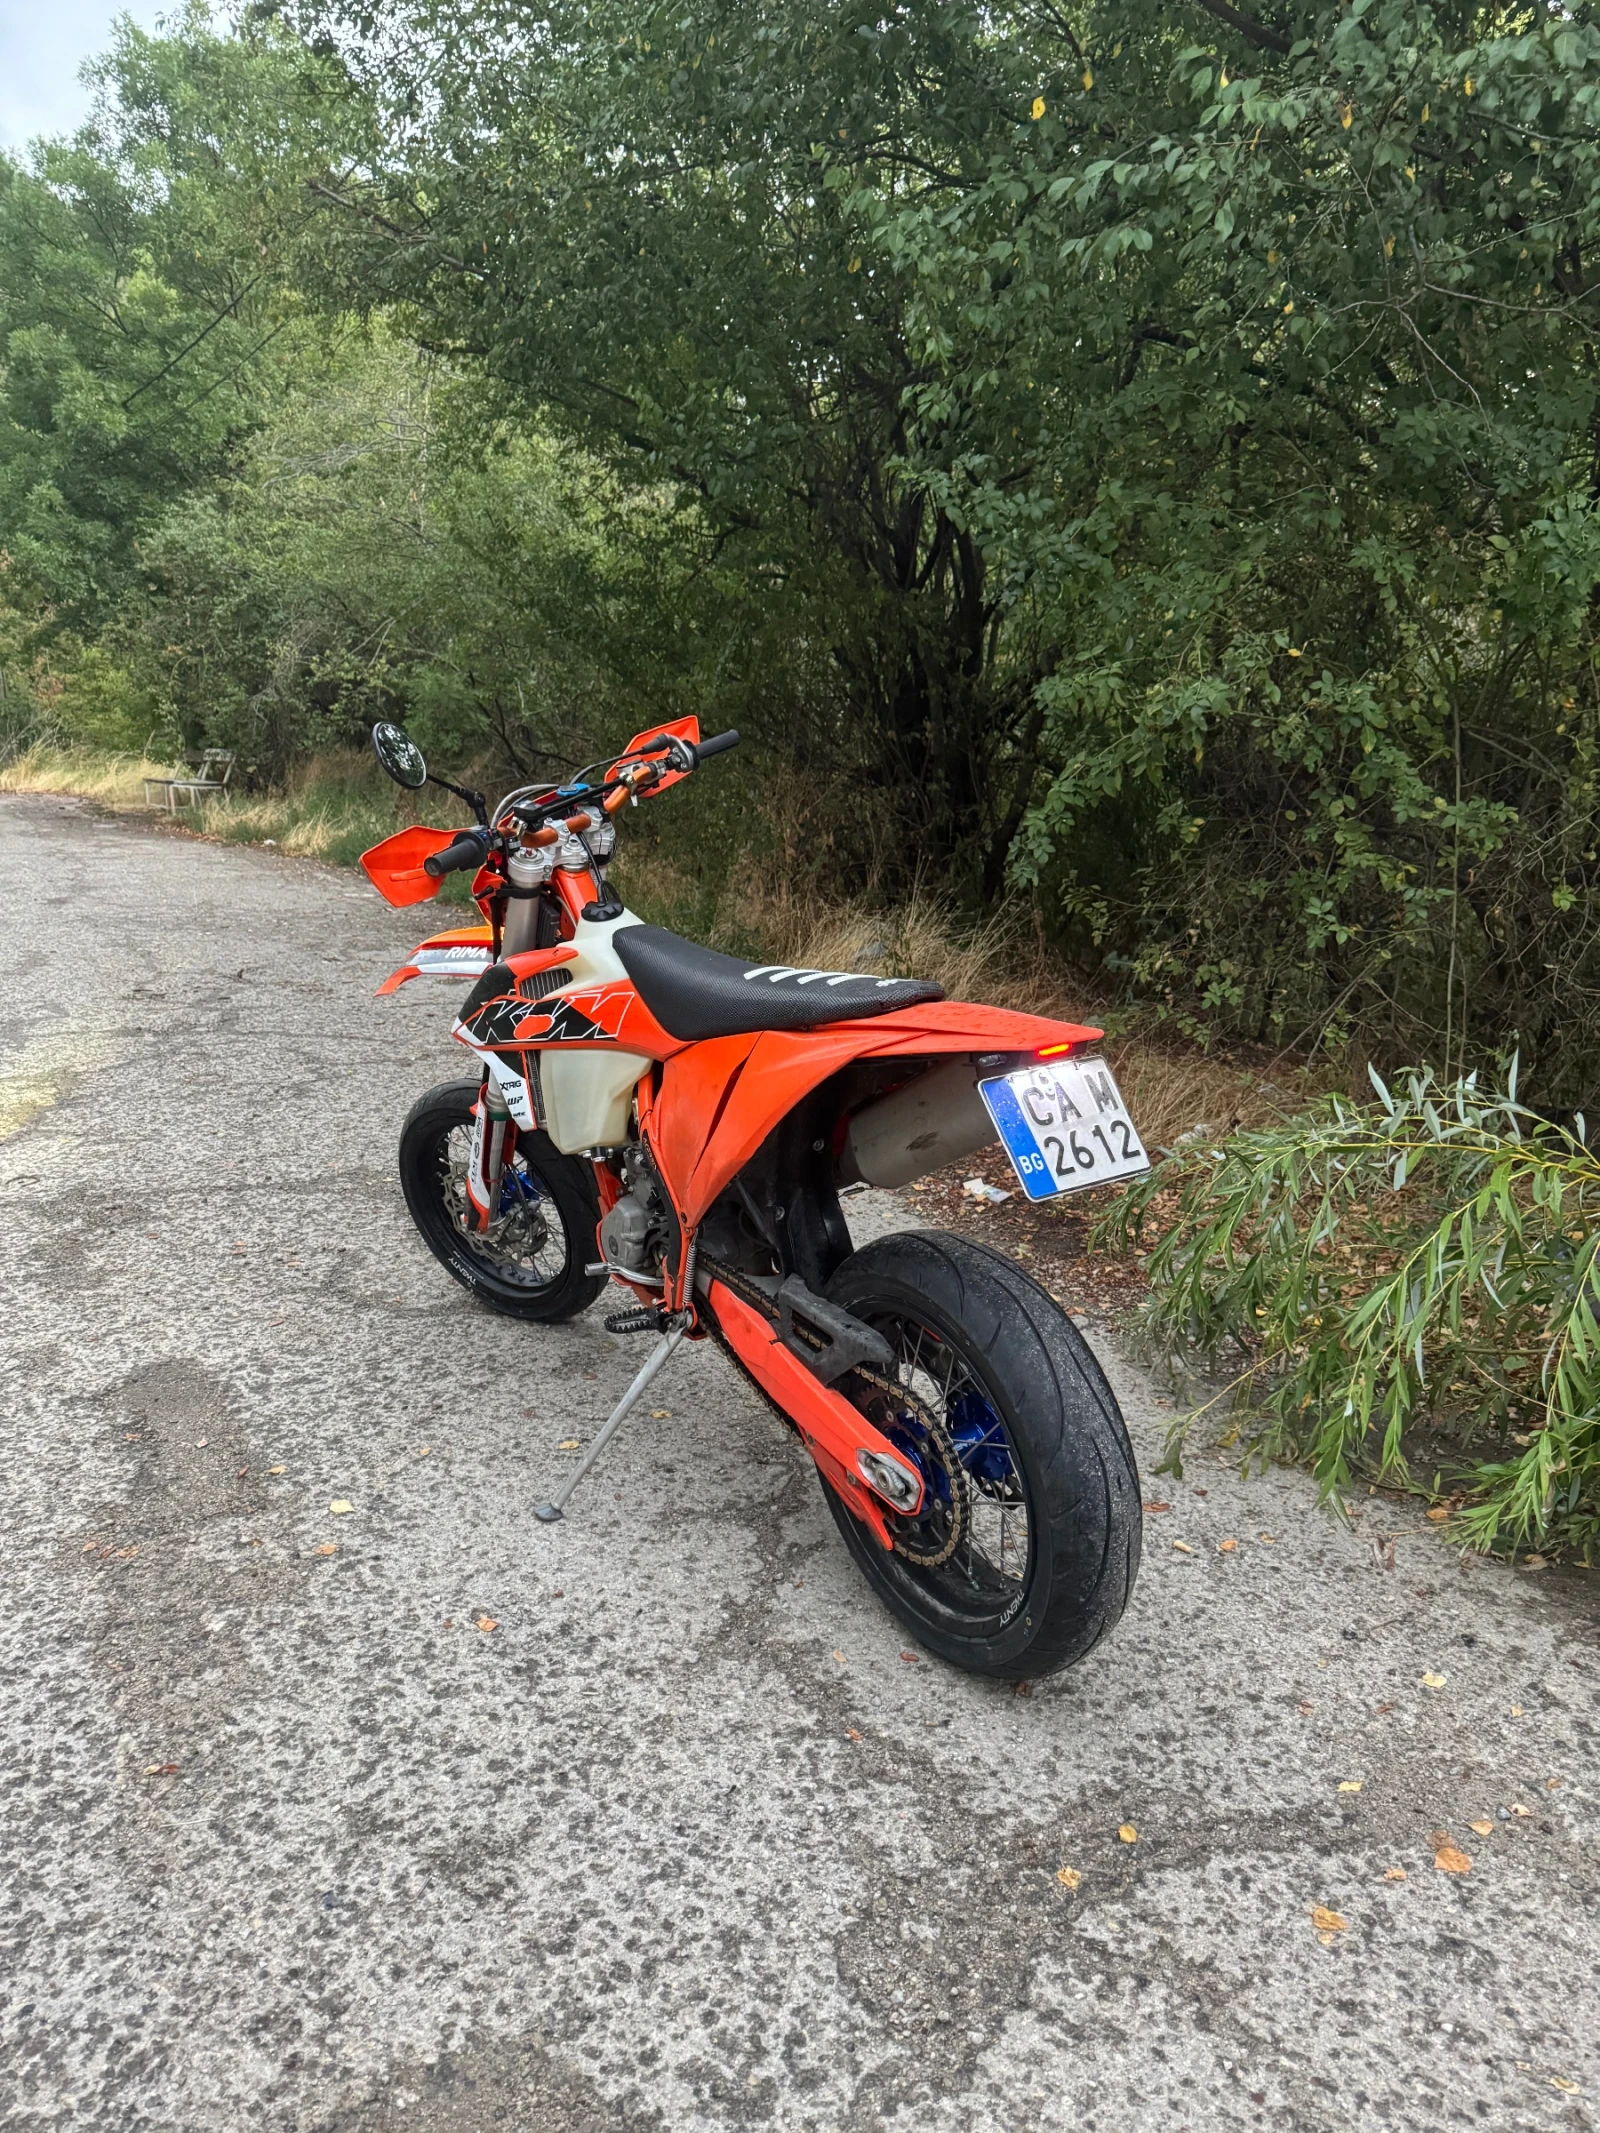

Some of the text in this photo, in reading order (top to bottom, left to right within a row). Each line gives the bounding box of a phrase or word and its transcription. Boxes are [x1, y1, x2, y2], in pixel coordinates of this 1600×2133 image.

[445, 946, 488, 959] RIMA
[500, 1079, 522, 1092] XTRIG
[507, 1095, 524, 1106] WP
[1022, 1071, 1119, 1126] CA M
[1043, 1119, 1141, 1177] 2612
[1018, 1152, 1045, 1174] BG
[447, 1257, 477, 1286] TWENTY
[999, 1588, 1025, 1628] TWENTY
